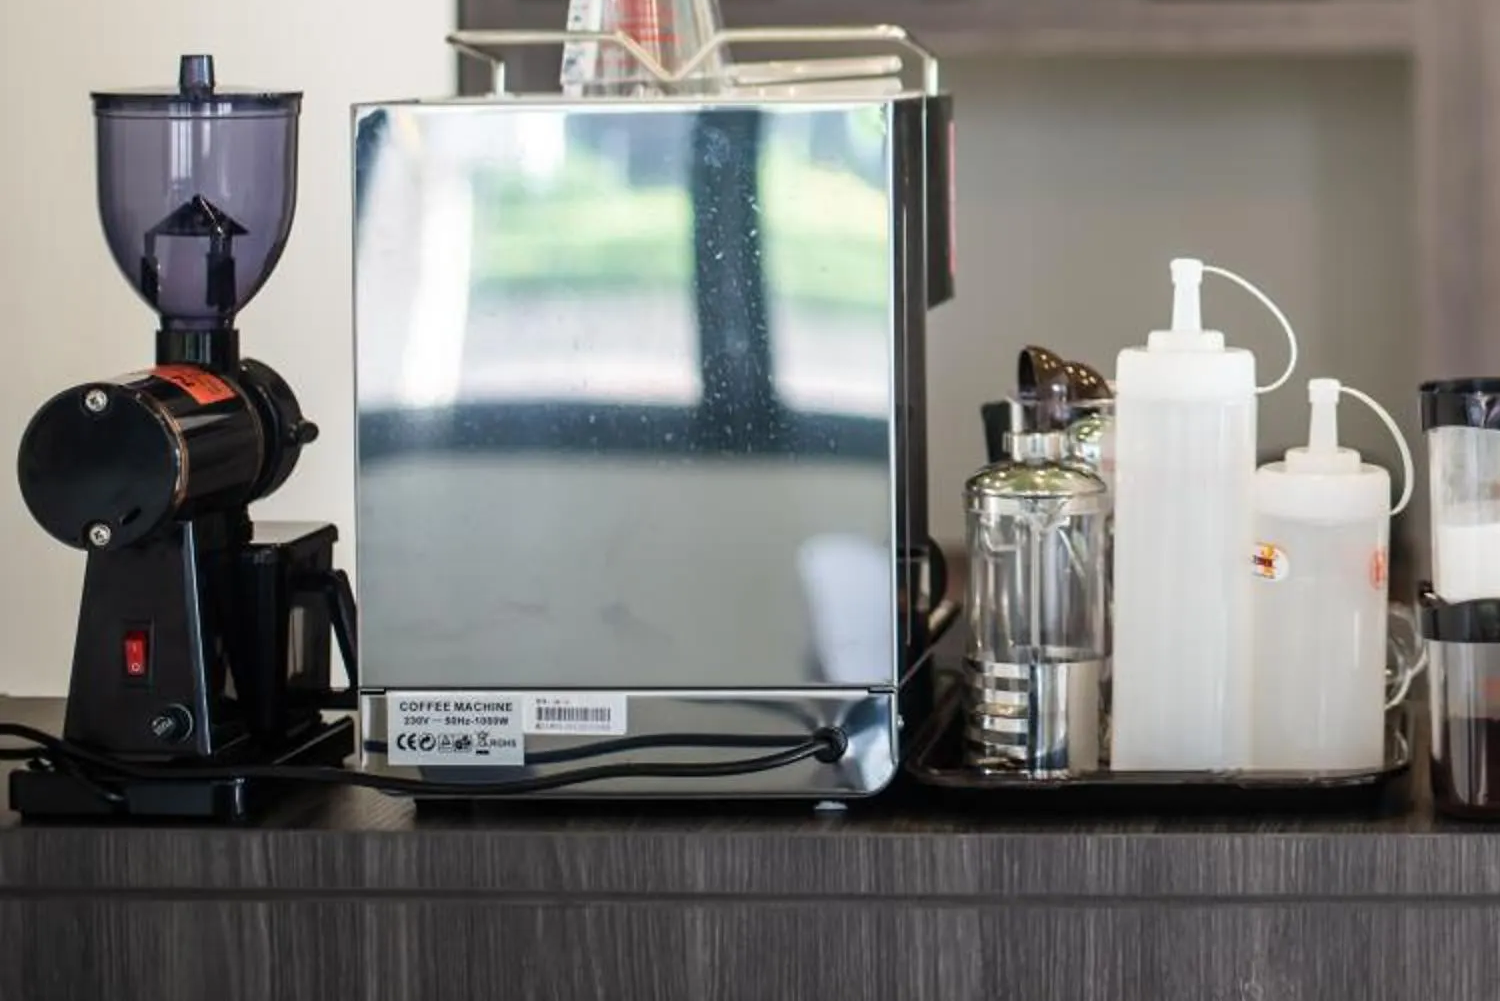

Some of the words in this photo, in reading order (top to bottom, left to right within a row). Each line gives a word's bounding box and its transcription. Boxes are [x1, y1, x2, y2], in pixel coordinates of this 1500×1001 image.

[399, 701, 450, 712] COFFEE
[453, 701, 513, 712] MACHINE
[396, 732, 418, 751] CE
